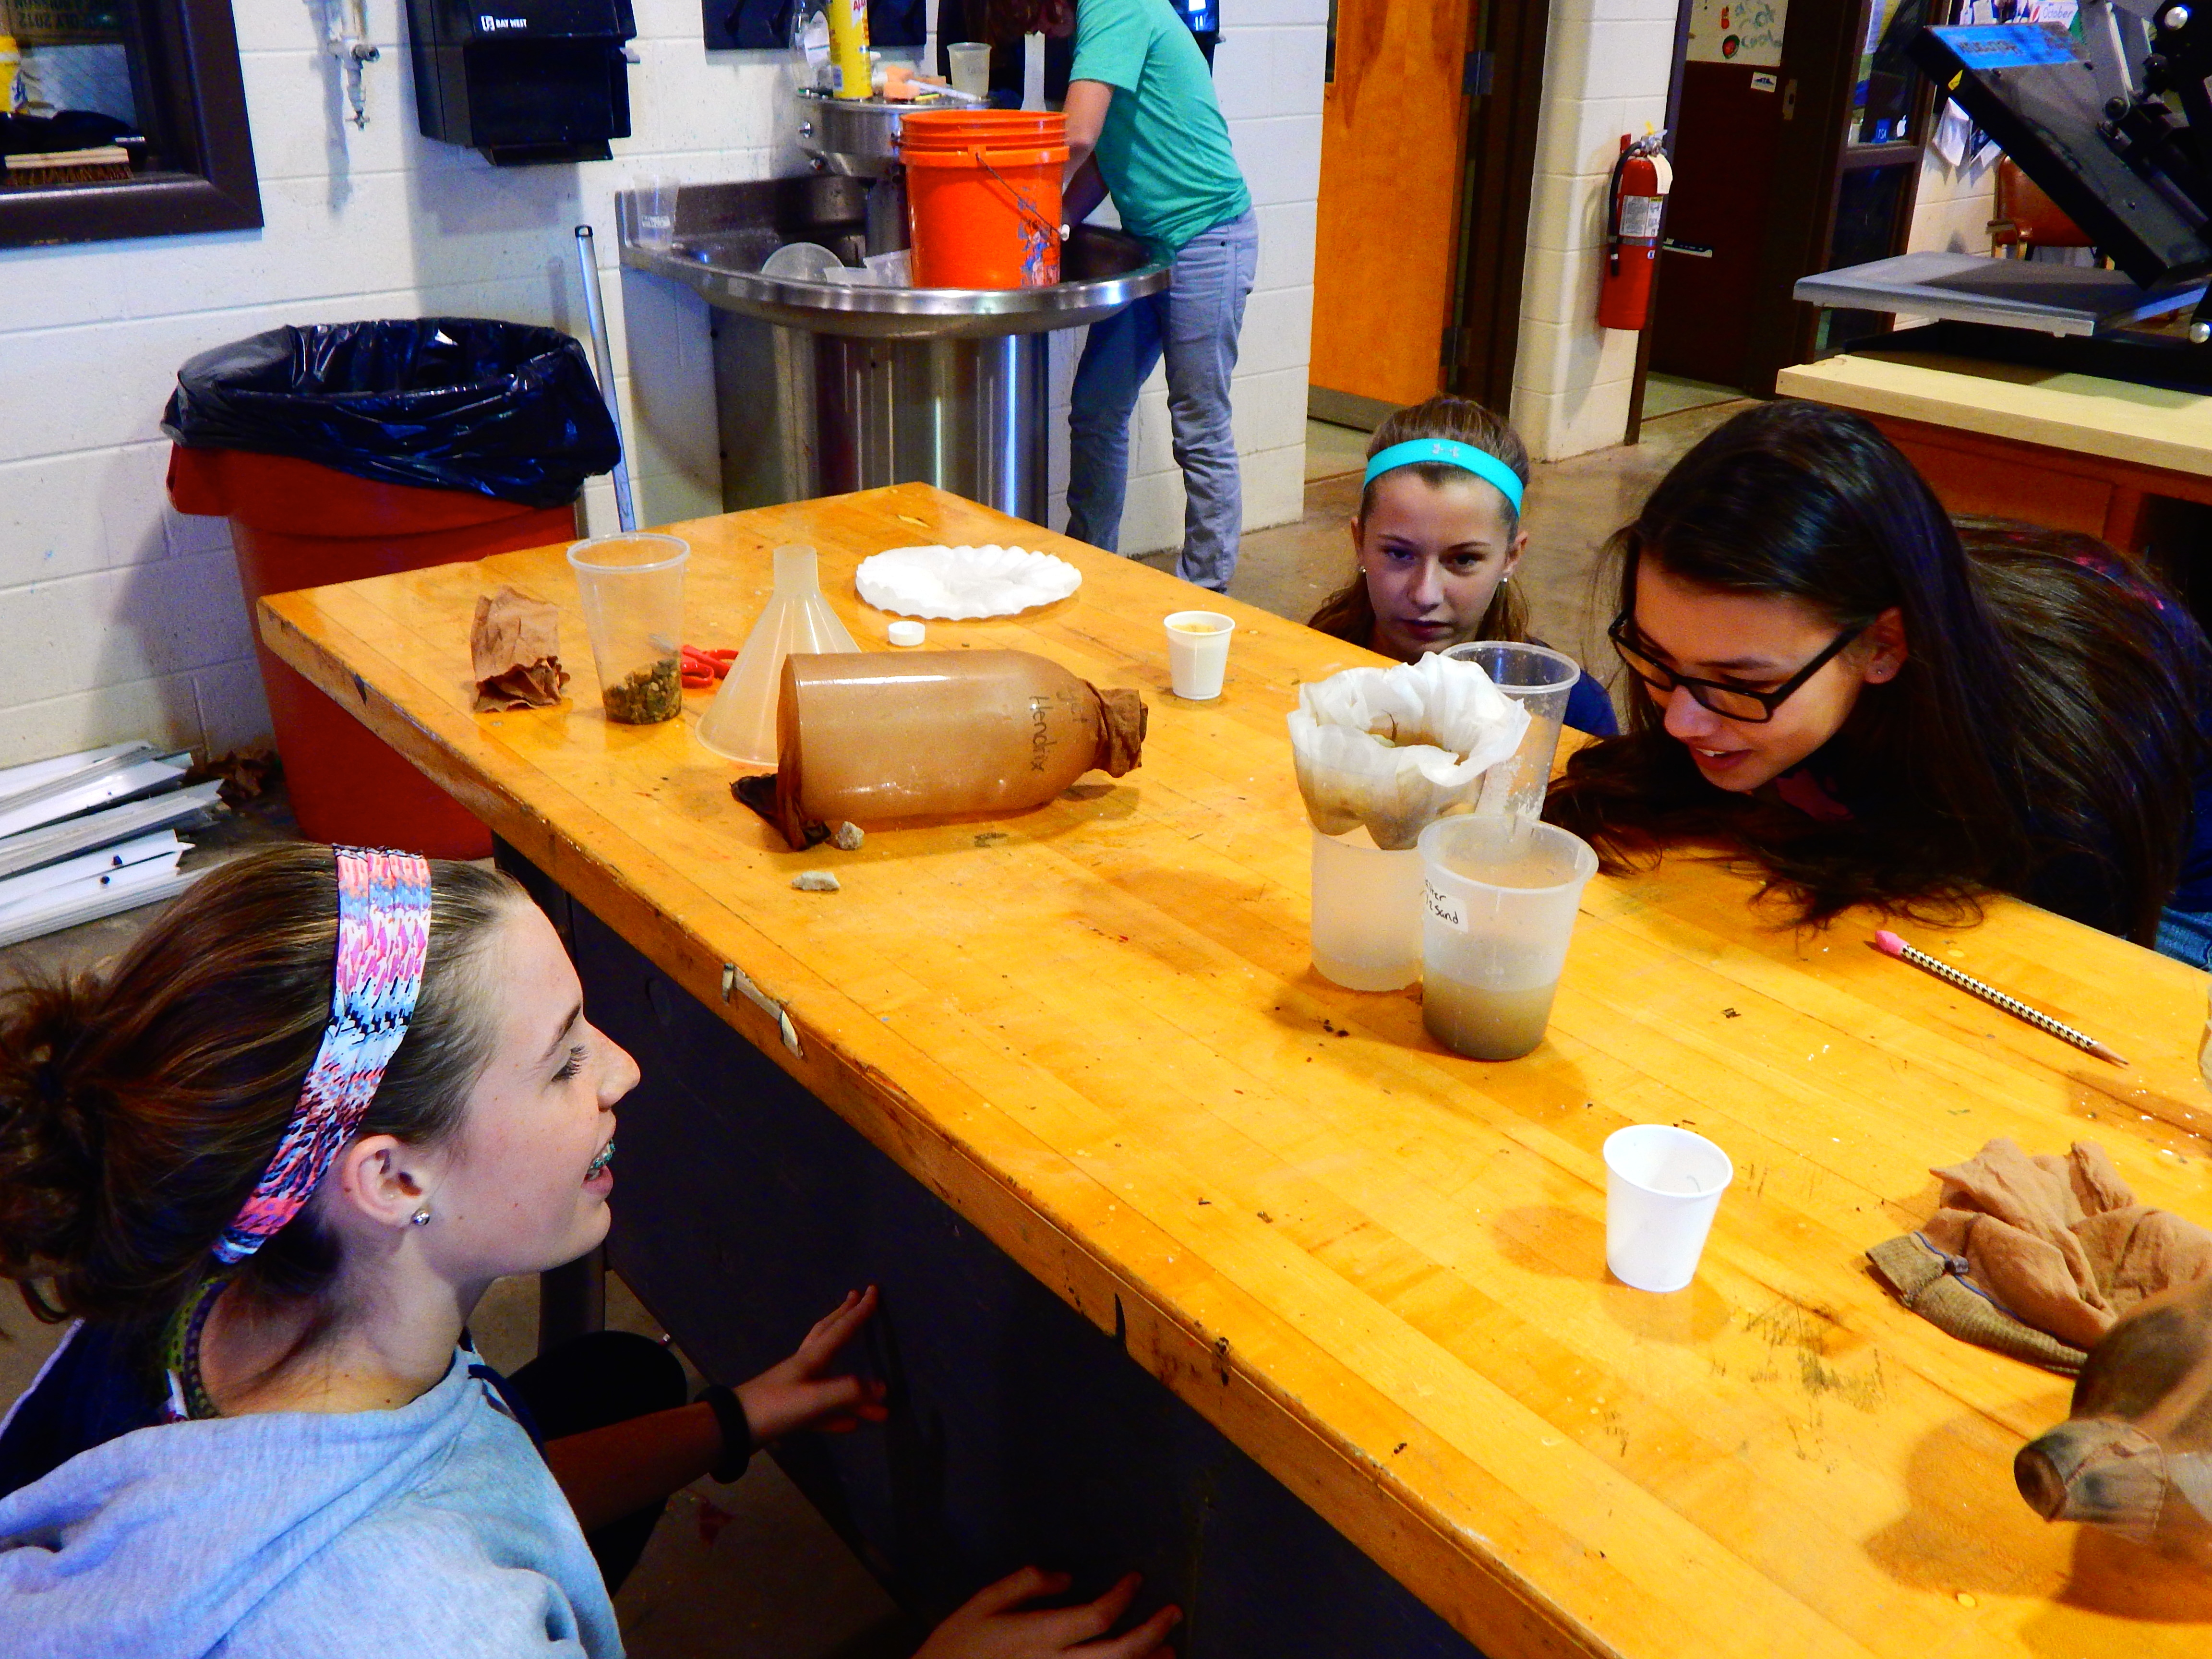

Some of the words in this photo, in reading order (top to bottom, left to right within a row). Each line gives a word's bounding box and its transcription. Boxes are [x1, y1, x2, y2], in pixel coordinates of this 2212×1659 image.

[2044, 5, 2073, 18] October
[495, 19, 508, 28] BAY
[510, 19, 527, 28] WEST
[1029, 696, 1058, 772] Hendrix
[1425, 878, 1446, 901] ilter
